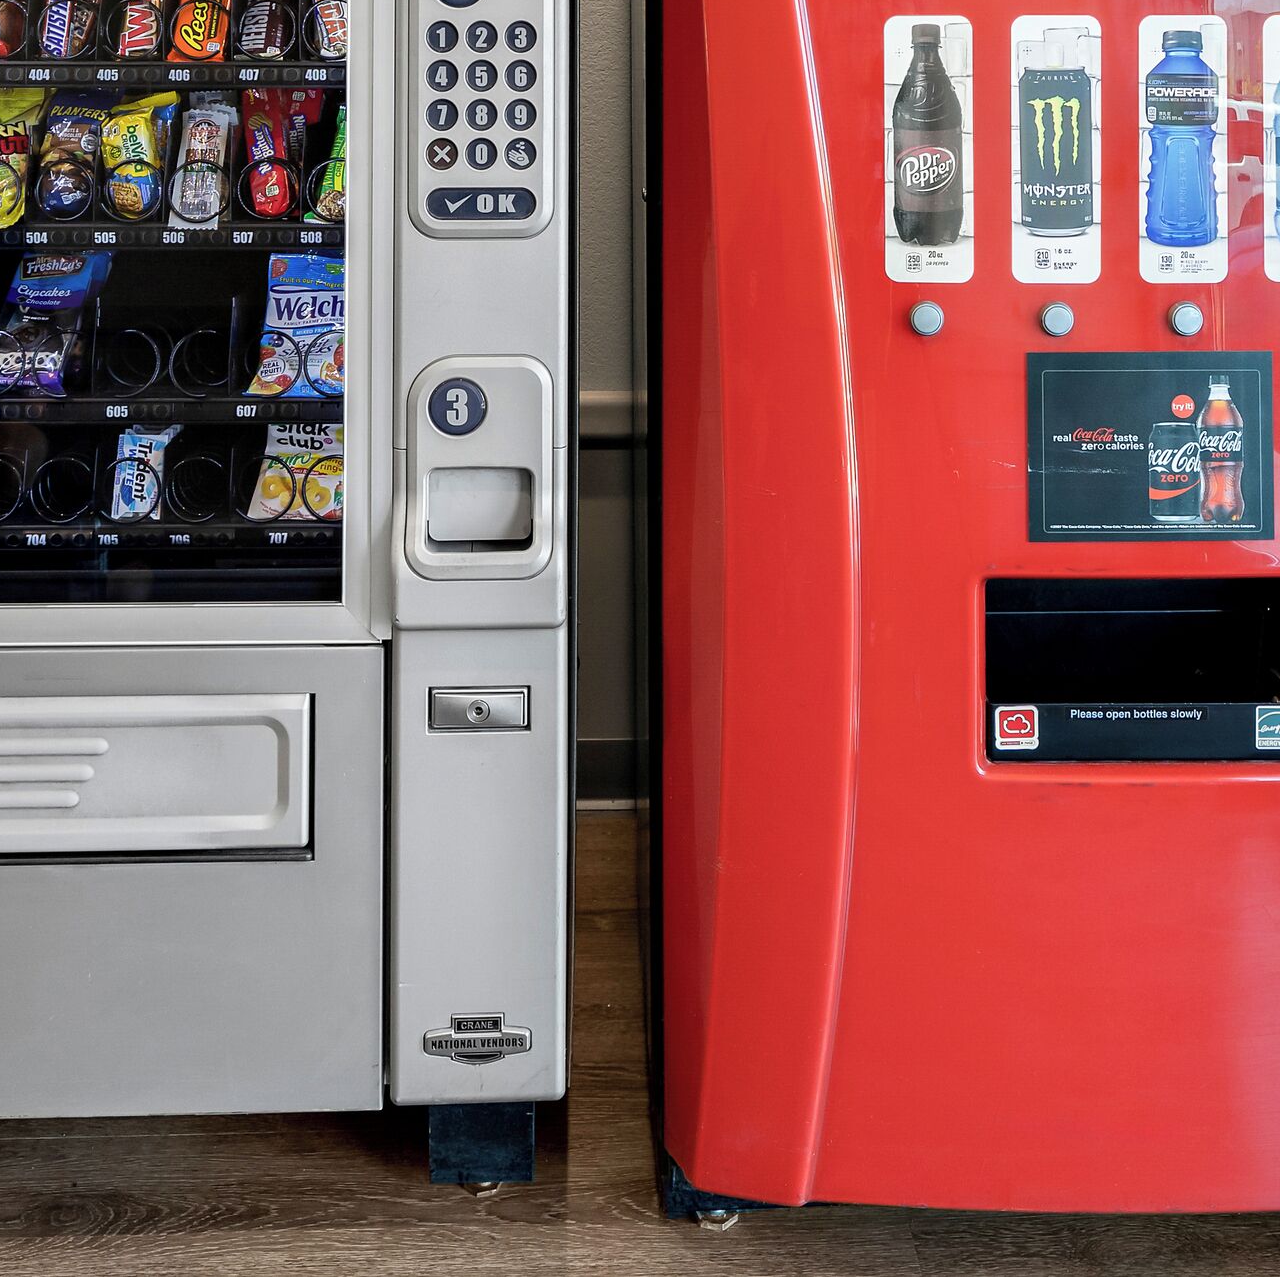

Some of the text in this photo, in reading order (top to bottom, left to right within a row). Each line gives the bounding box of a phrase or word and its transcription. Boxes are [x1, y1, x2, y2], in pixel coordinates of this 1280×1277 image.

[436, 26, 527, 48] 1 2 3
[29, 68, 51, 81] 404
[96, 68, 119, 81] 405
[168, 68, 191, 81] 406
[239, 68, 260, 81] 407
[305, 68, 327, 81] 408
[435, 66, 528, 87] 4 5 6
[1147, 87, 1217, 97] POWERADE
[50, 105, 106, 122] PLANTERS
[437, 105, 528, 126] 7 8 9
[254, 130, 275, 159] Butter
[475, 143, 488, 165] 0
[919, 152, 941, 167] Dr
[905, 156, 954, 188] Pepper
[1023, 183, 1091, 199] MONSTER
[476, 194, 516, 214] OK
[25, 232, 48, 244] 504
[94, 232, 117, 244] 505
[162, 232, 185, 244] 506
[233, 232, 254, 244] 507
[300, 232, 322, 244] 508
[907, 255, 921, 263] 250
[1036, 251, 1048, 259] 210
[1161, 255, 1173, 263] 130
[27, 259, 83, 274] Freshley's
[17, 285, 71, 298] Cupcakes
[273, 295, 345, 321] Welch
[260, 367, 282, 377] FRUIT!
[105, 405, 128, 418] 605
[236, 405, 257, 417] 607
[447, 388, 469, 425] 3
[1172, 402, 1194, 411] try it!
[1053, 427, 1138, 442] real Coca-Cola taste
[276, 436, 324, 451] club
[1081, 441, 1145, 451] zero calories
[1160, 474, 1189, 483] zero
[25, 535, 47, 546] 704
[98, 534, 119, 546] 705
[268, 532, 289, 544] 707
[1070, 708, 1203, 721] Please open bottles slowly
[461, 1021, 494, 1030] CRANE
[431, 1038, 524, 1050] NATIONAL VENDORS
